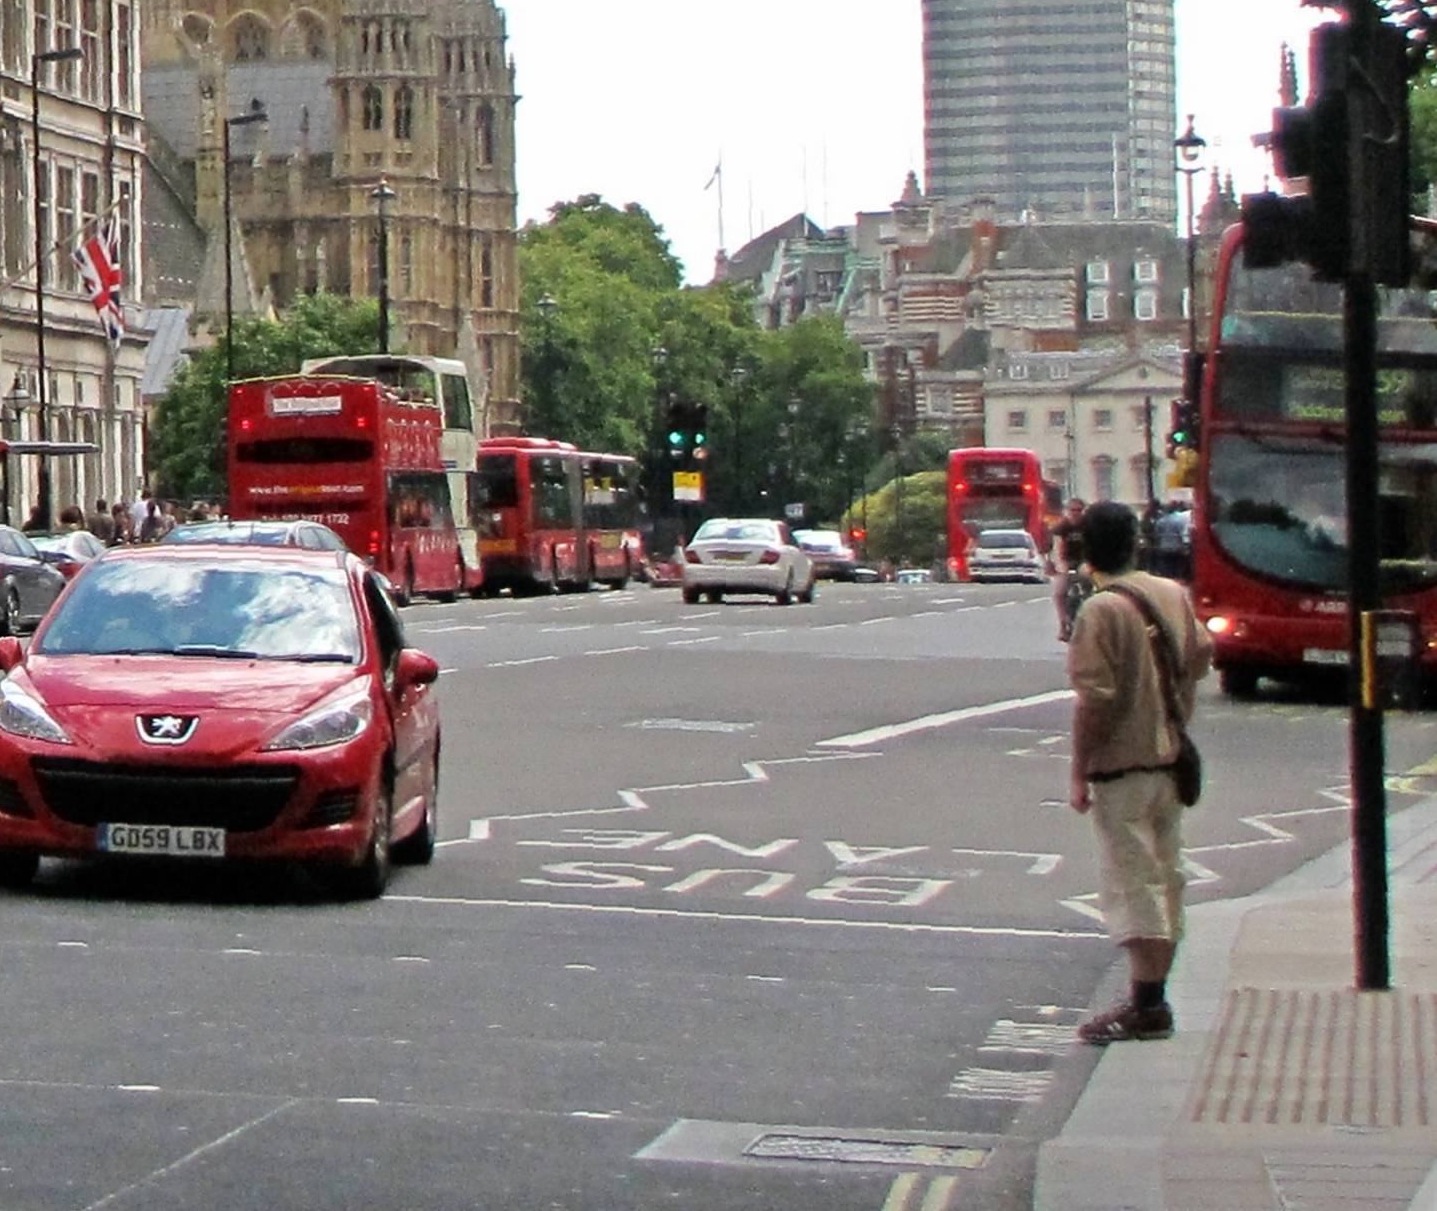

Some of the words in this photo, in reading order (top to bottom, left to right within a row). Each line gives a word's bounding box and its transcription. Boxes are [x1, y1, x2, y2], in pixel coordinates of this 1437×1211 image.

[111, 827, 170, 849] GD59
[176, 829, 220, 851] LBX
[517, 829, 1064, 874] LANE
[518, 861, 955, 907] BUS
